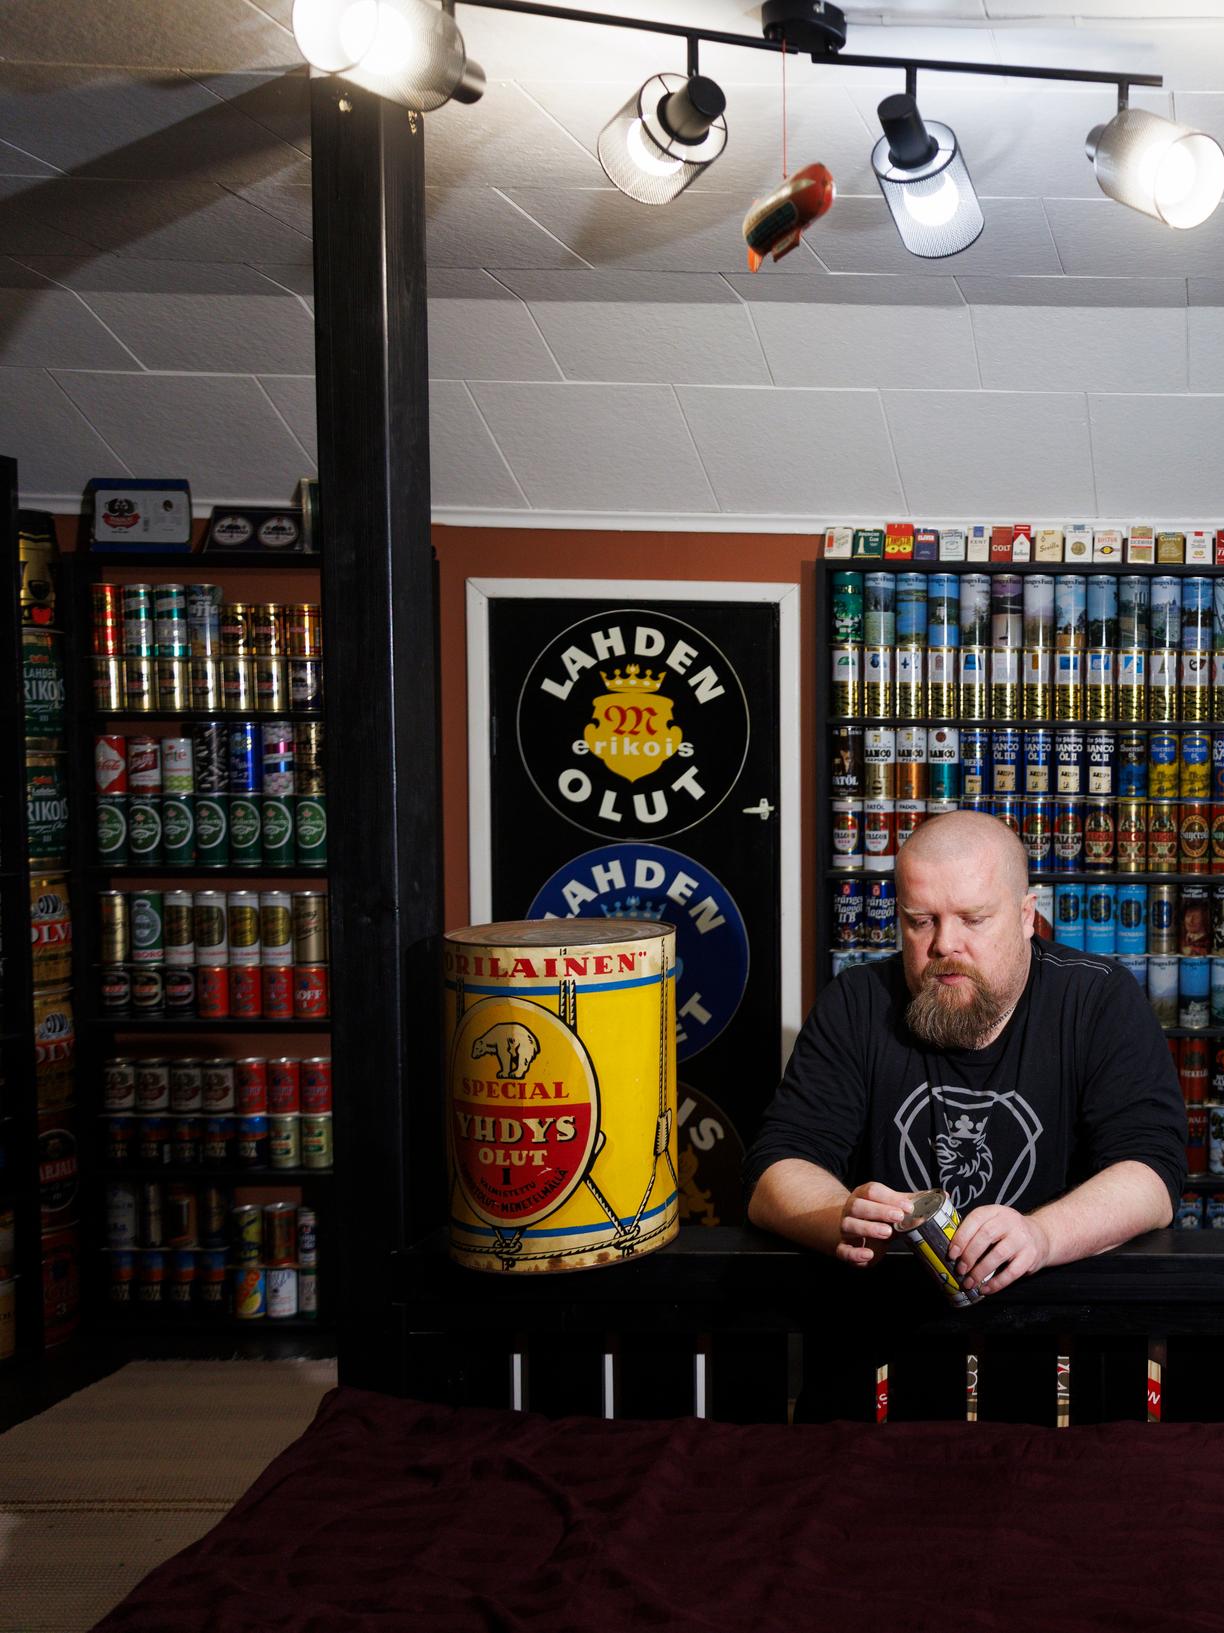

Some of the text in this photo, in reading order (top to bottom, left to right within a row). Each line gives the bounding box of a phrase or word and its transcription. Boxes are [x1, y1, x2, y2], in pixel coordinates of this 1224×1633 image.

[541, 626, 726, 705] LAHDEN
[571, 737, 695, 758] erikois
[558, 765, 706, 823] OLUT
[26, 800, 68, 822] RIKOIS
[544, 859, 726, 935] AHDEN
[443, 951, 647, 978] ORILAINEN"
[462, 1077, 569, 1100] SPECIAL
[456, 1111, 577, 1144] YHDYS
[478, 1147, 548, 1166] OLUT
[502, 1168, 511, 1186] I
